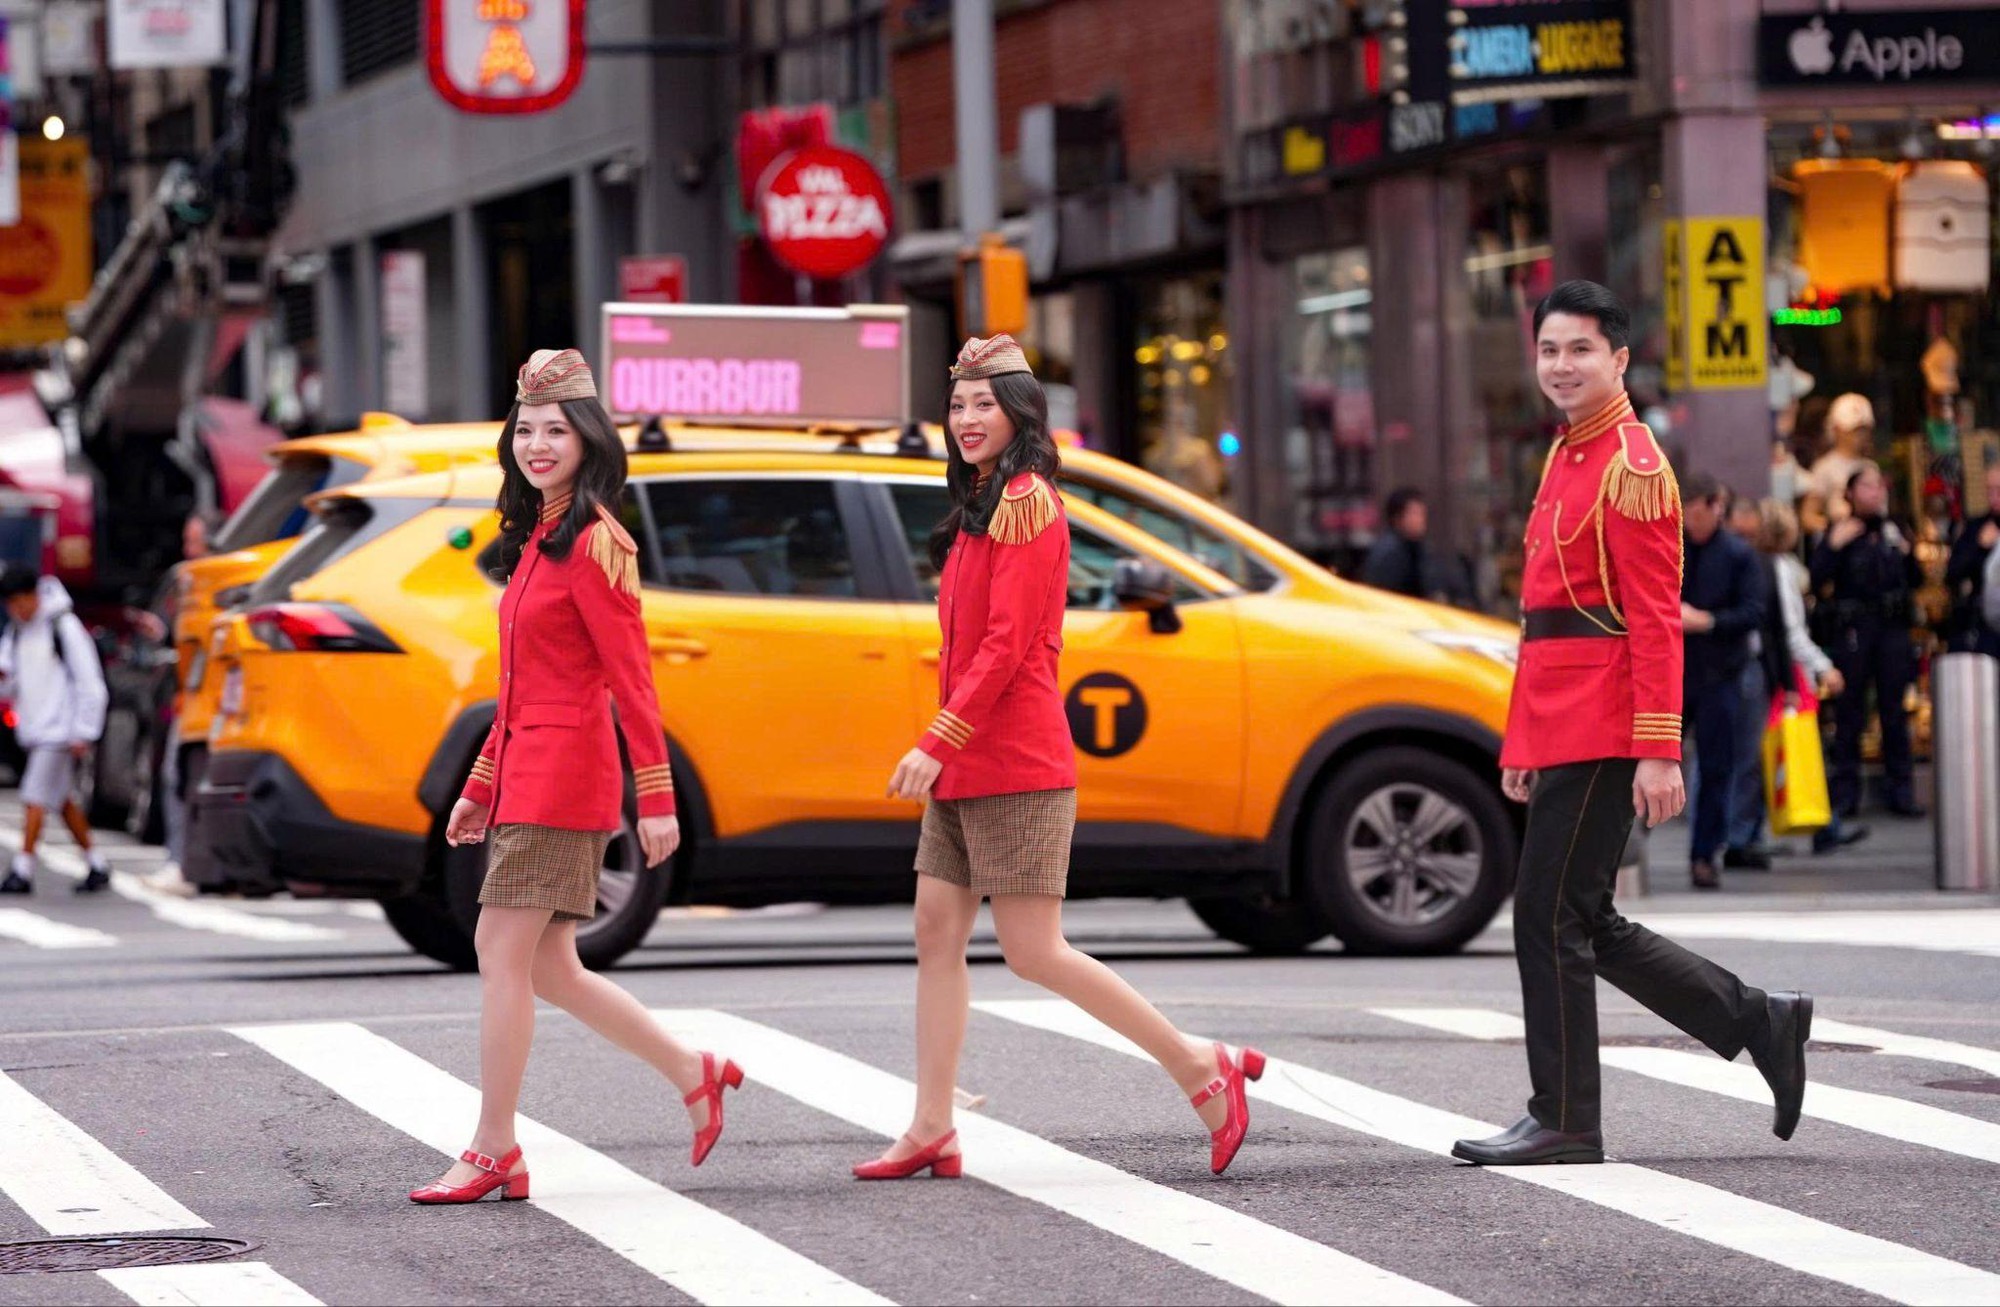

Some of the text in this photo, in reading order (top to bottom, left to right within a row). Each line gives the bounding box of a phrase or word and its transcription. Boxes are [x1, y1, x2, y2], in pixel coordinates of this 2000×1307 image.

[1538, 19, 1624, 73] LUGGAGE
[1841, 28, 1963, 80] Apple
[1390, 101, 1446, 152] SONY
[764, 194, 888, 242] PIZZA
[1705, 229, 1748, 358] ATM
[1080, 686, 1131, 750] T
